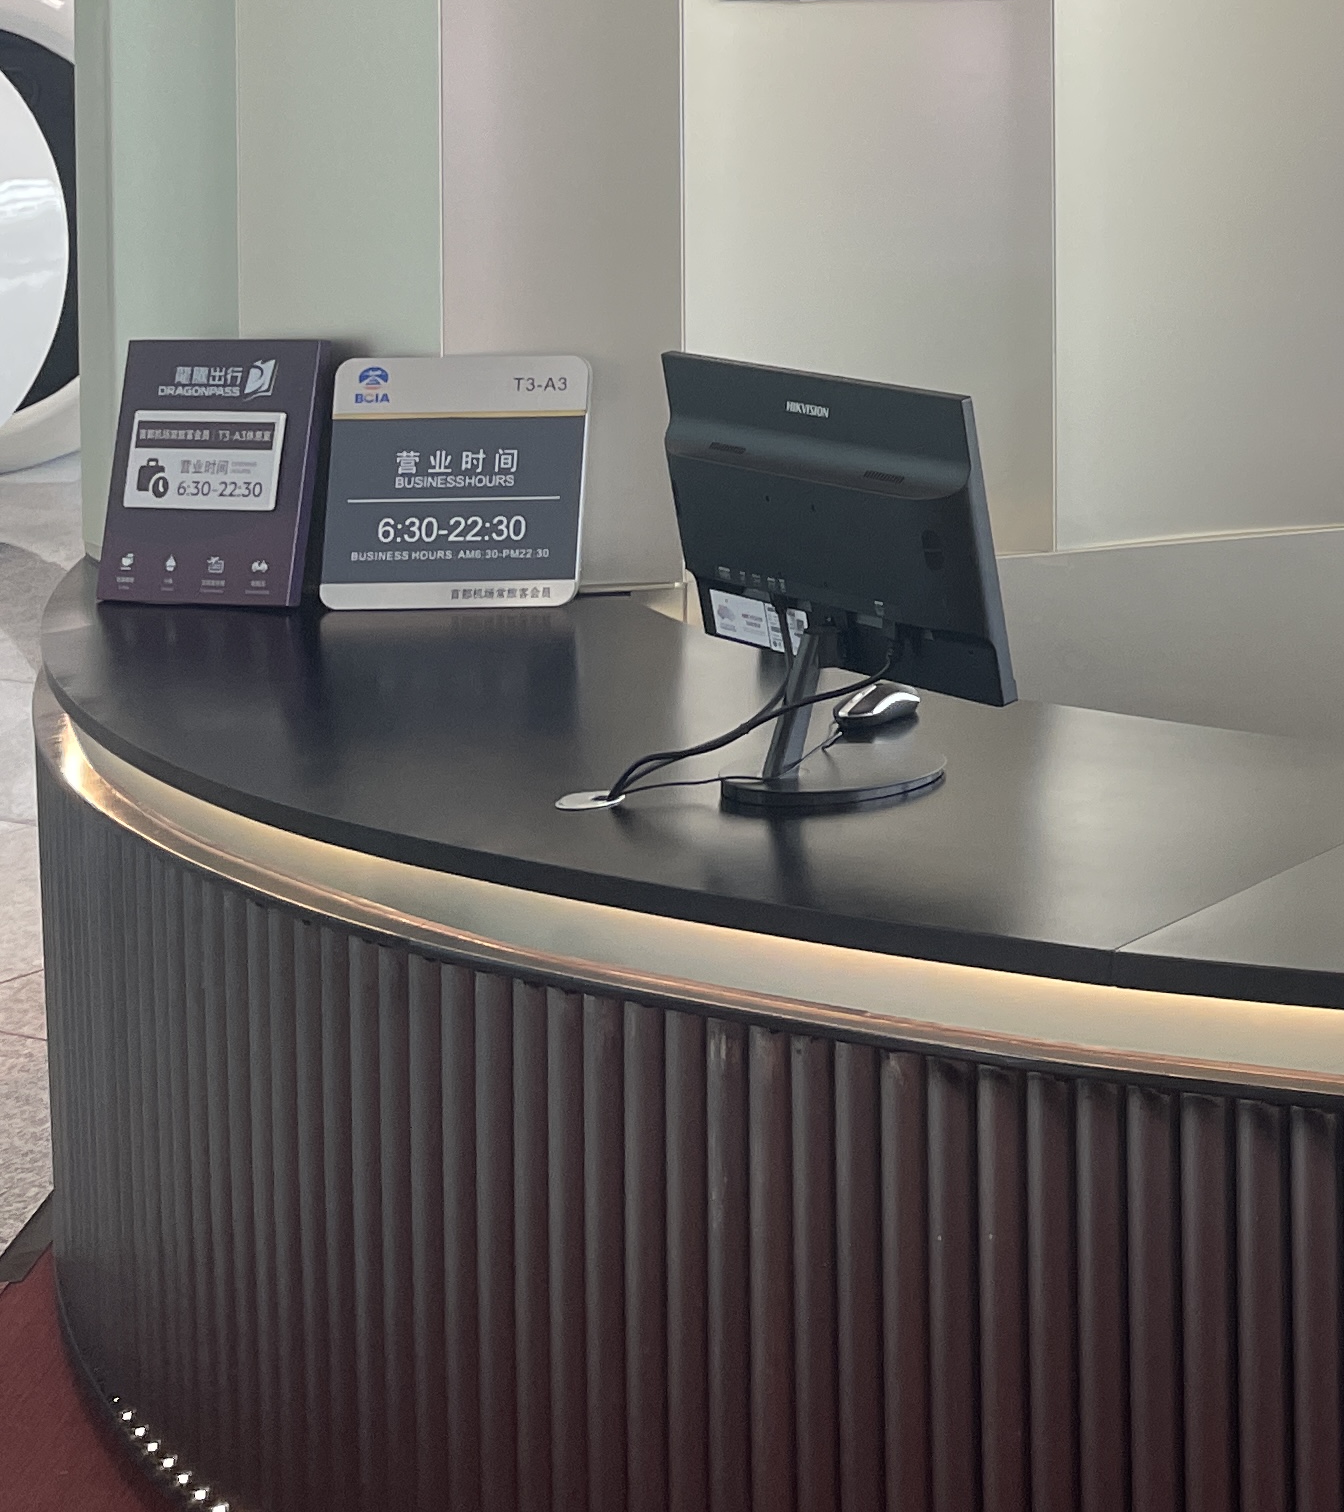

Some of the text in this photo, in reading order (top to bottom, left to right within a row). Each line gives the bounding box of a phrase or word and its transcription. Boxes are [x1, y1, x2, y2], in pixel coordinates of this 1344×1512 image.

[158, 385, 240, 397] DRAGONPASS
[514, 377, 568, 392] T3-A3
[354, 393, 390, 404] BCIA
[786, 400, 830, 418] HIKVISION
[396, 449, 518, 475] 营业时间
[177, 480, 263, 498] 6:30-22:30
[395, 475, 515, 489] BUSINESSHOURS
[377, 515, 526, 543] 6:30-22:30
[351, 551, 409, 562] BUSINESS
